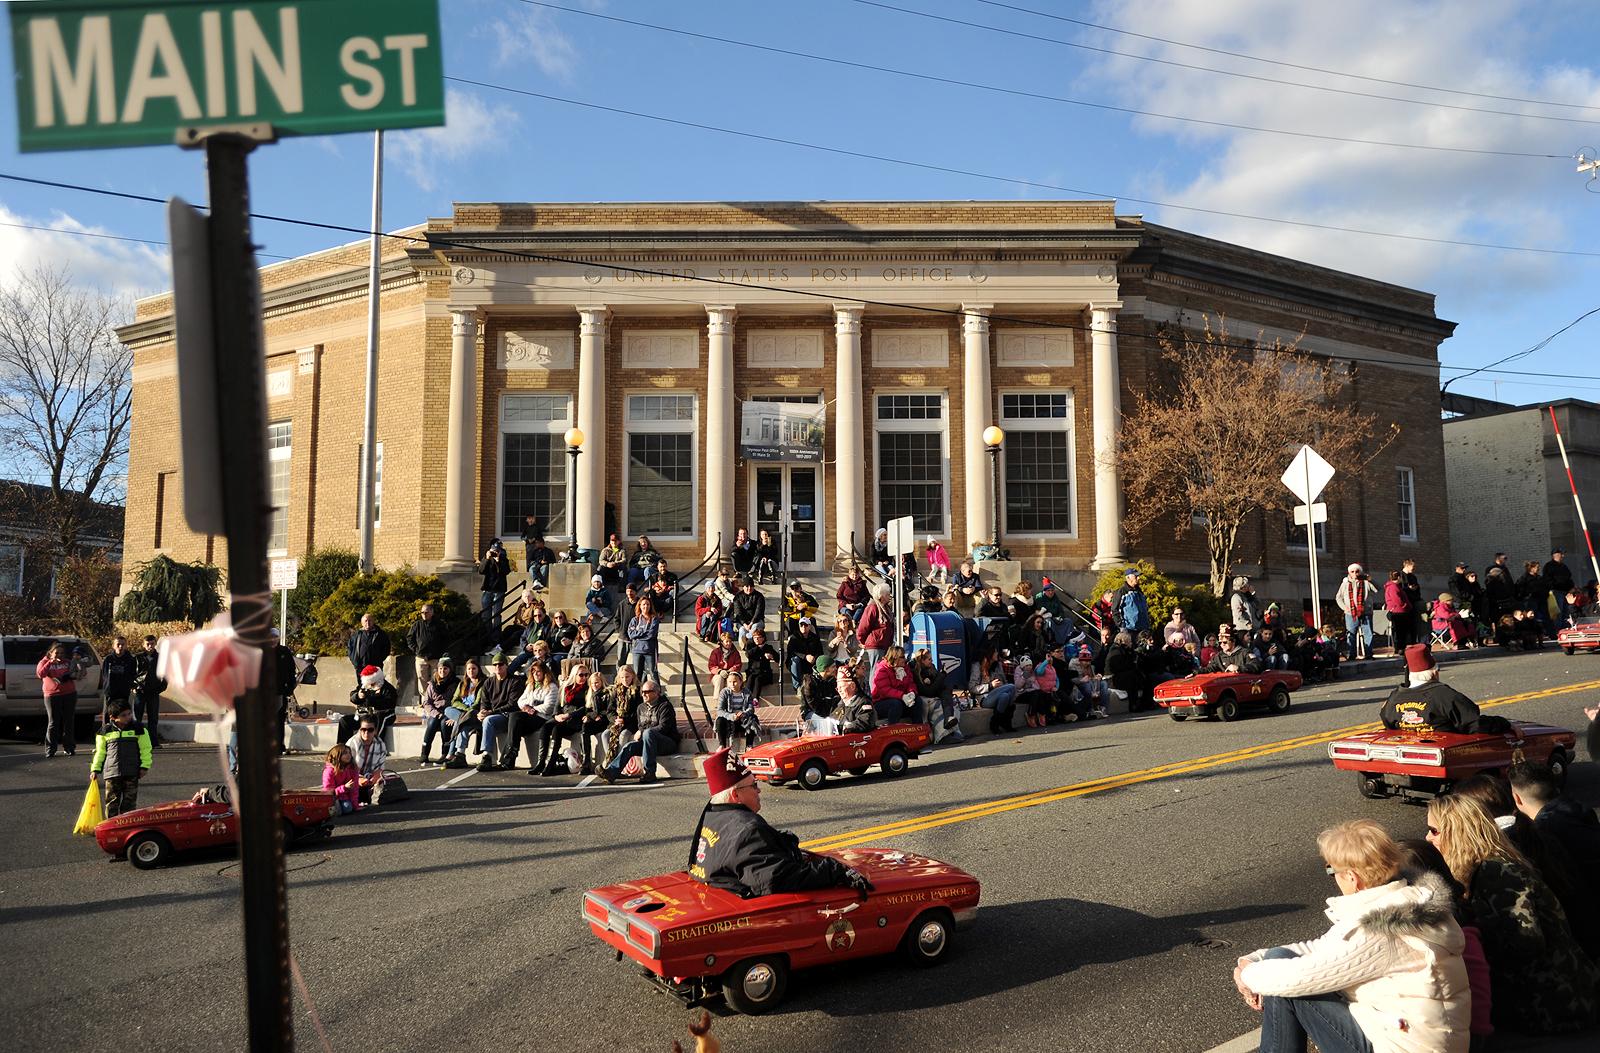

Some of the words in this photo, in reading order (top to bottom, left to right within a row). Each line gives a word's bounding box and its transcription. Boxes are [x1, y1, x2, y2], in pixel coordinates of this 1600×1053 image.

[29, 7, 304, 128] MAIN
[339, 34, 429, 110] ST
[615, 268, 696, 282] UNITED
[718, 268, 789, 282] STATES
[811, 268, 862, 282] POST
[882, 268, 954, 282] OFFICE
[1395, 701, 1428, 713] Pyramid
[791, 745, 811, 753] MOTOR
[812, 740, 833, 750] PATROL
[115, 816, 145, 826] MOTOR
[149, 811, 181, 821] PATROL
[887, 893, 926, 906] MOTOR
[930, 887, 970, 900] PATROL
